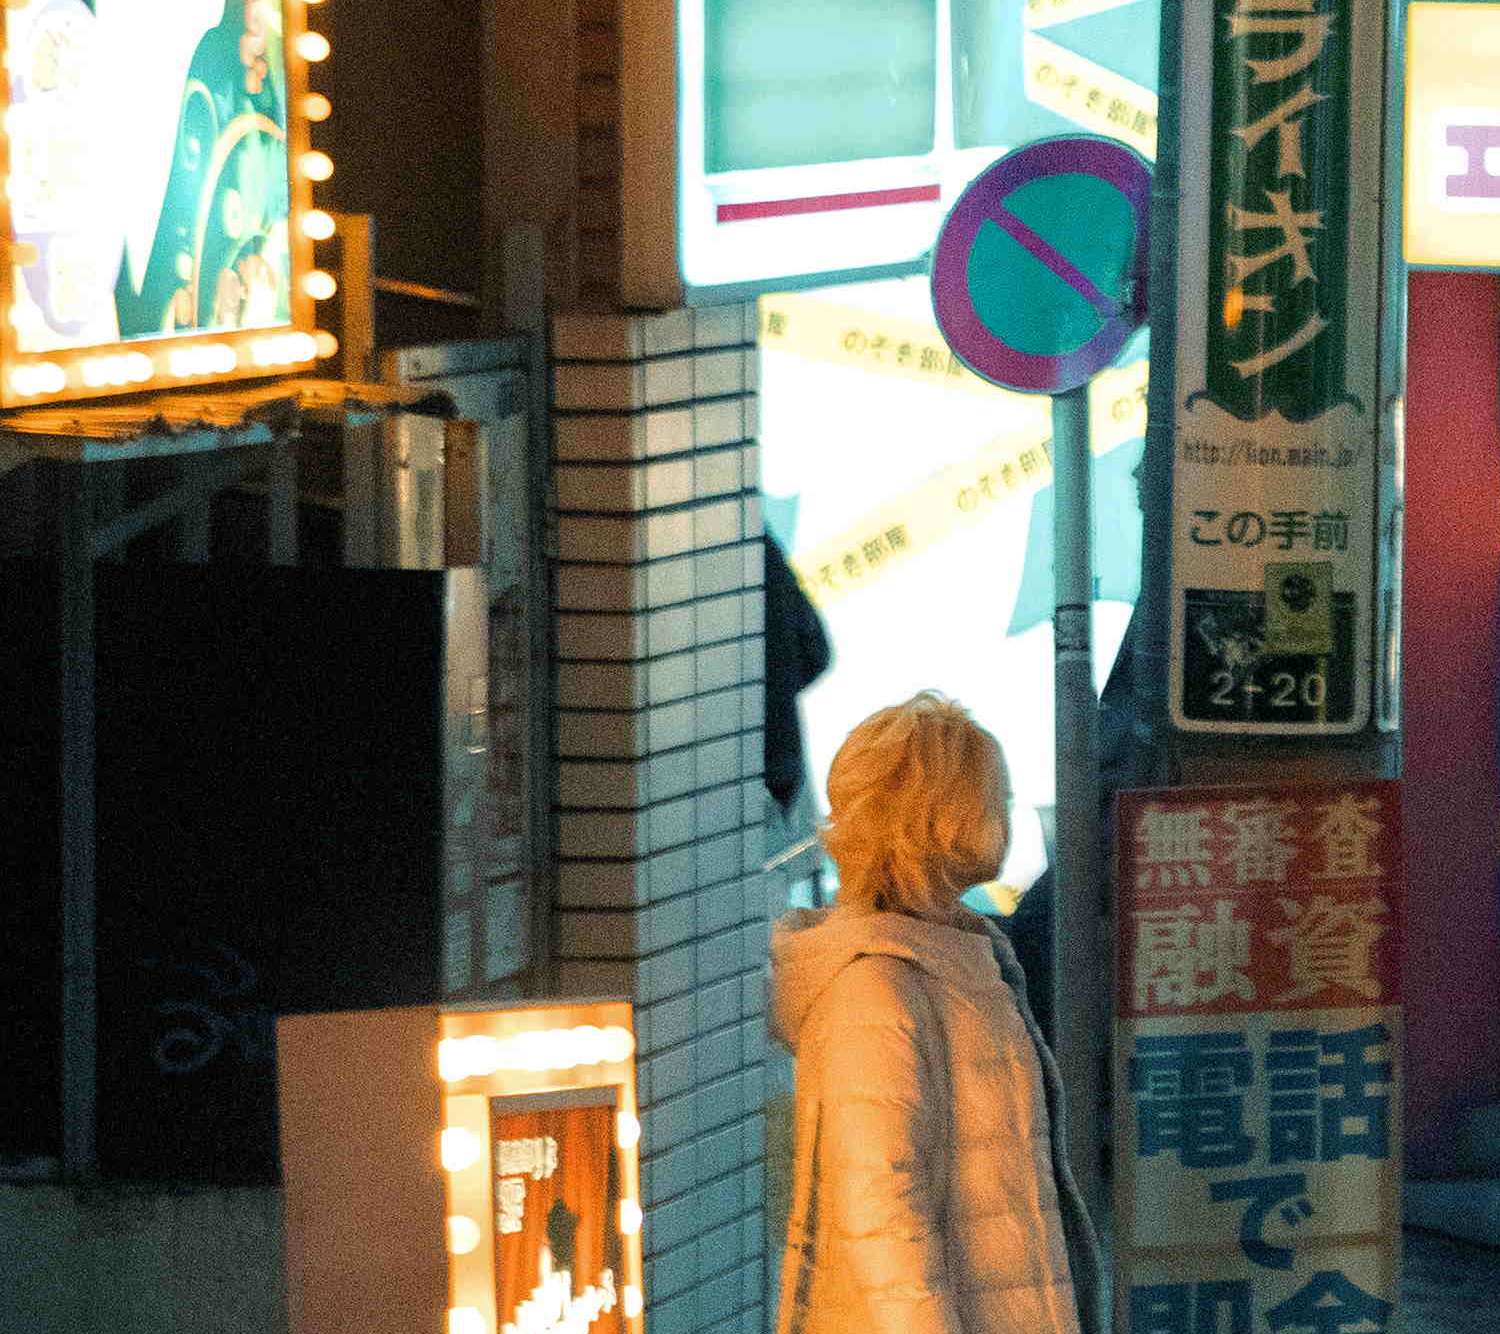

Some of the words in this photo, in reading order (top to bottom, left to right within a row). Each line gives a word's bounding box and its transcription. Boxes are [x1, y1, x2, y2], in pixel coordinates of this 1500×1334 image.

[1189, 509, 1351, 552] この手前
[1138, 793, 1386, 888] 無審査
[1132, 895, 1387, 1008] 融資
[1132, 1022, 1391, 1169] 電話
[1208, 1171, 1314, 1268] で
